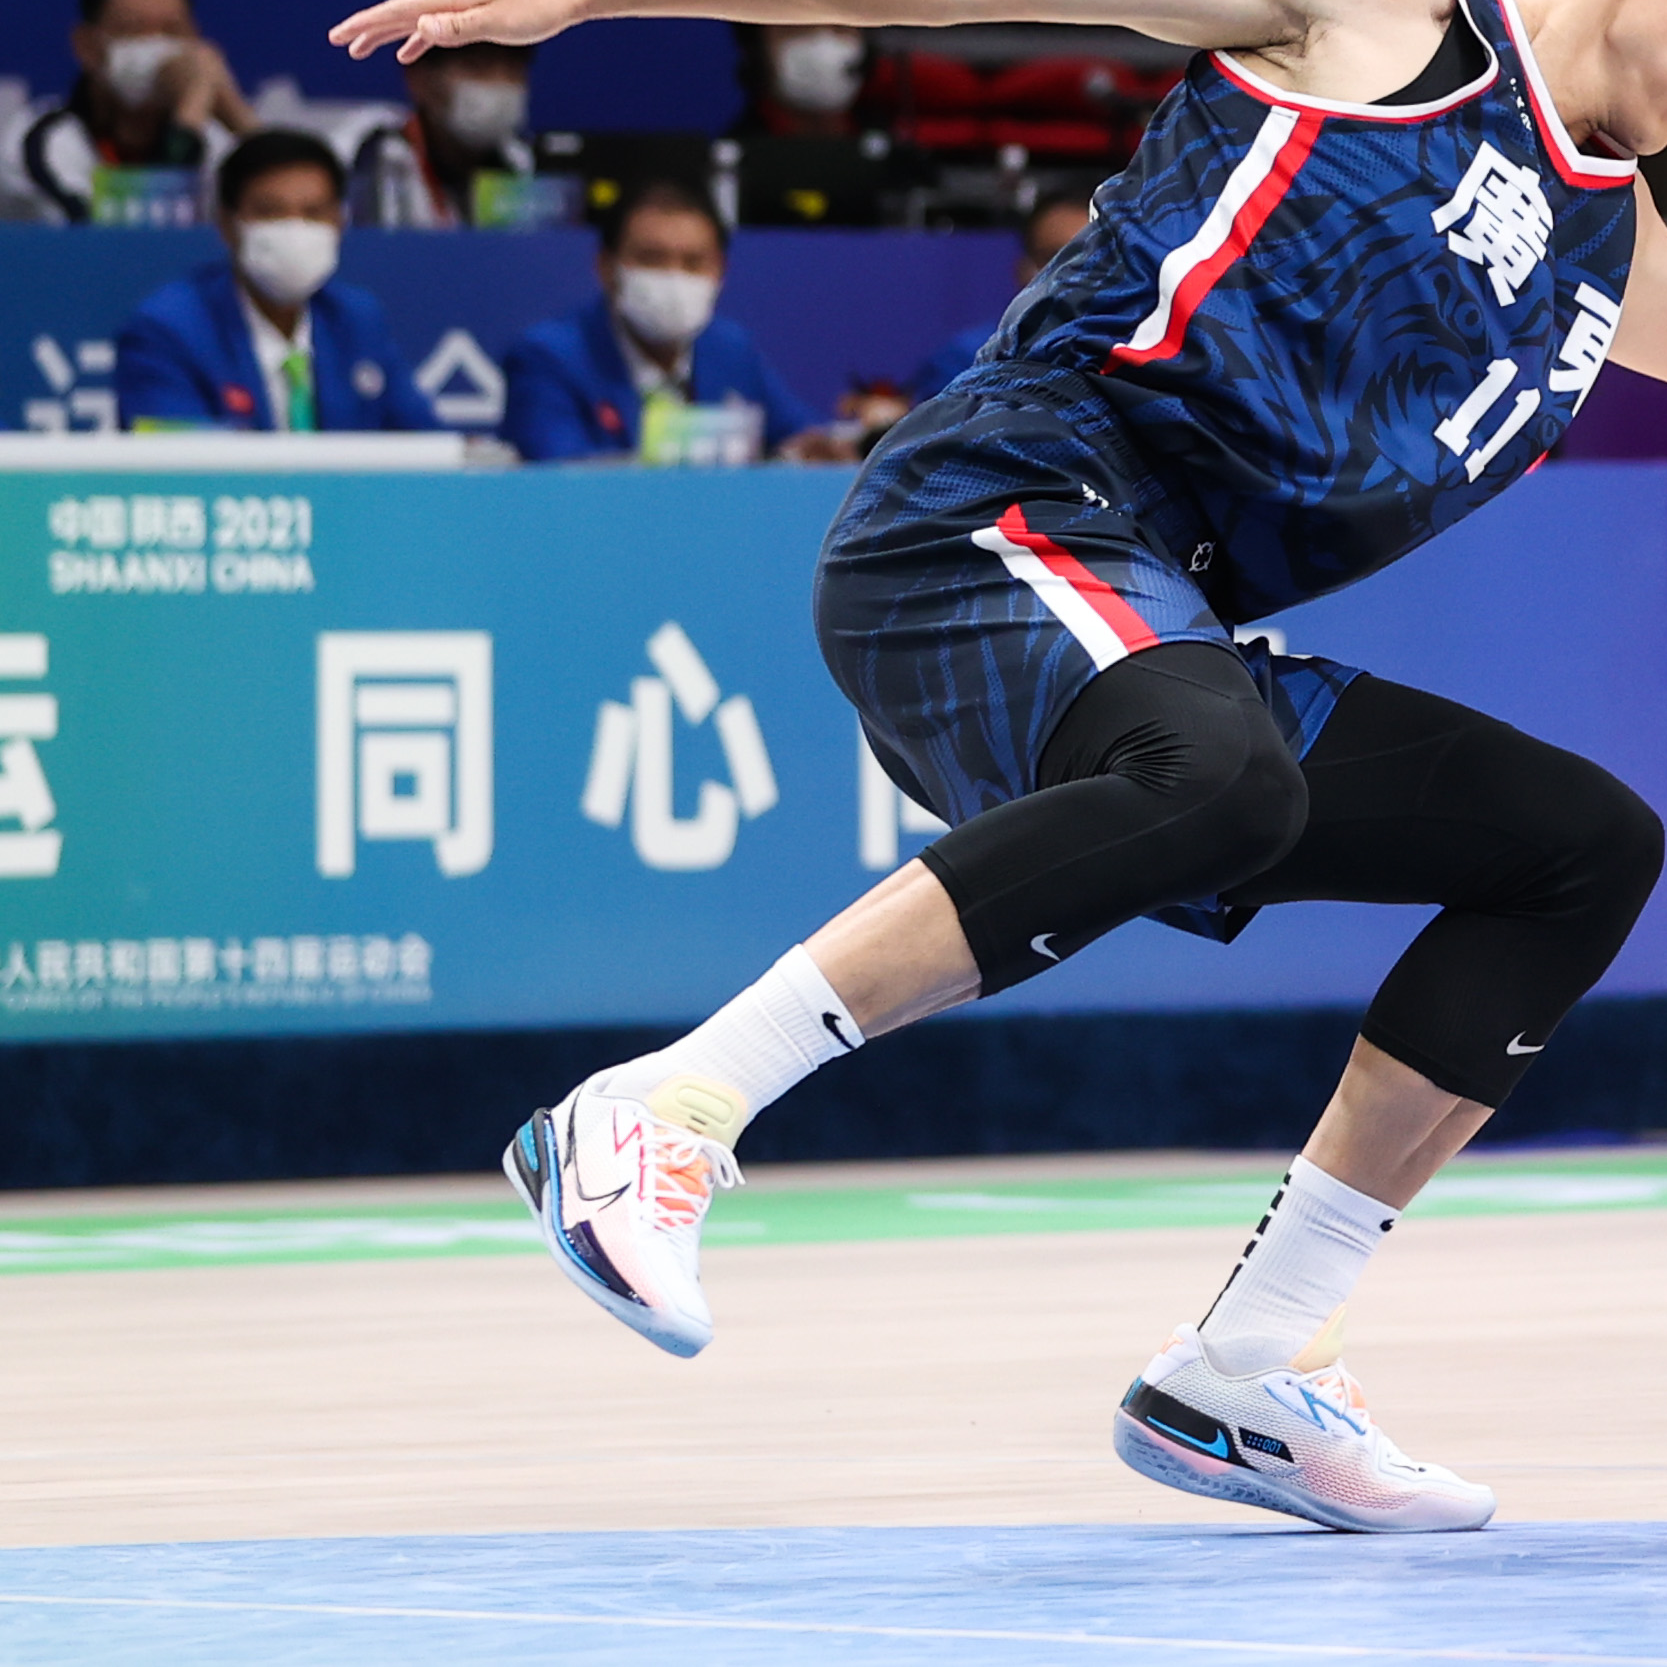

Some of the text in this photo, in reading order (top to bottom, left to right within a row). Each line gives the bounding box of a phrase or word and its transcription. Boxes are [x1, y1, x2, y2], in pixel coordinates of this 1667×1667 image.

[1433, 356, 1542, 485] 11
[213, 495, 312, 550] 2021
[49, 551, 315, 595] SHAANXI CHINA
